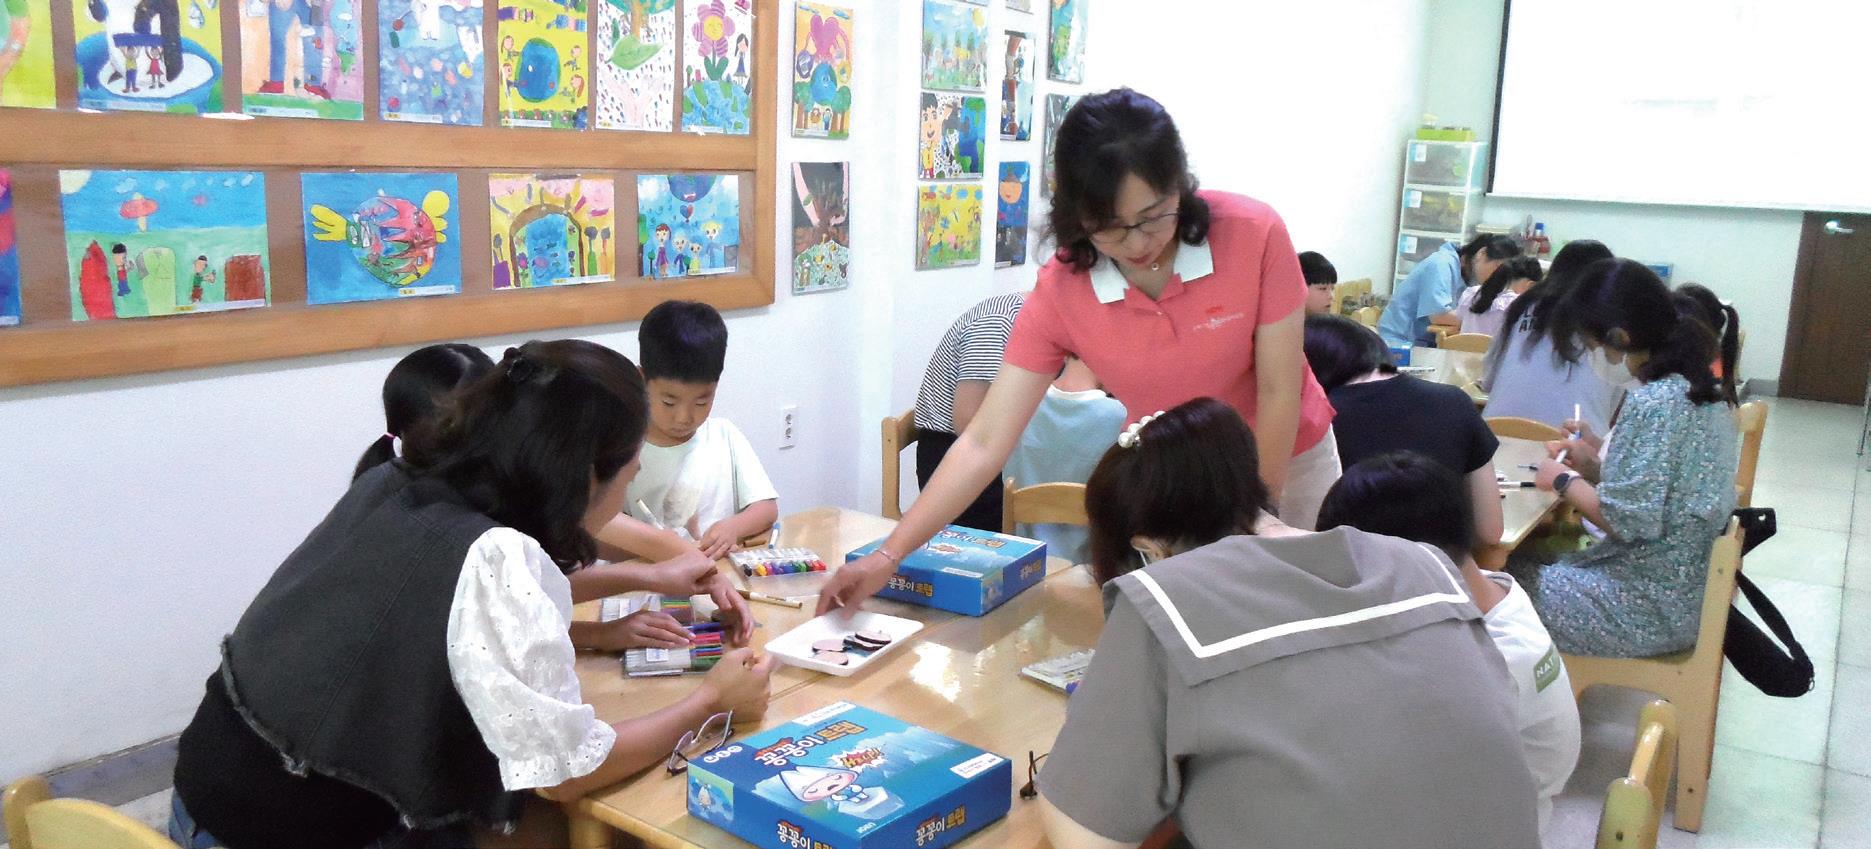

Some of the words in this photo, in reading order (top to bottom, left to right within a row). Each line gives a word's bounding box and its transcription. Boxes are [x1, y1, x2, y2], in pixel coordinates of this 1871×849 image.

[753, 735, 825, 767] 꽁꽁이
[815, 719, 867, 742] 트랩
[776, 822, 811, 849] 꽁꽁이
[915, 818, 946, 847] 꽁꽁이
